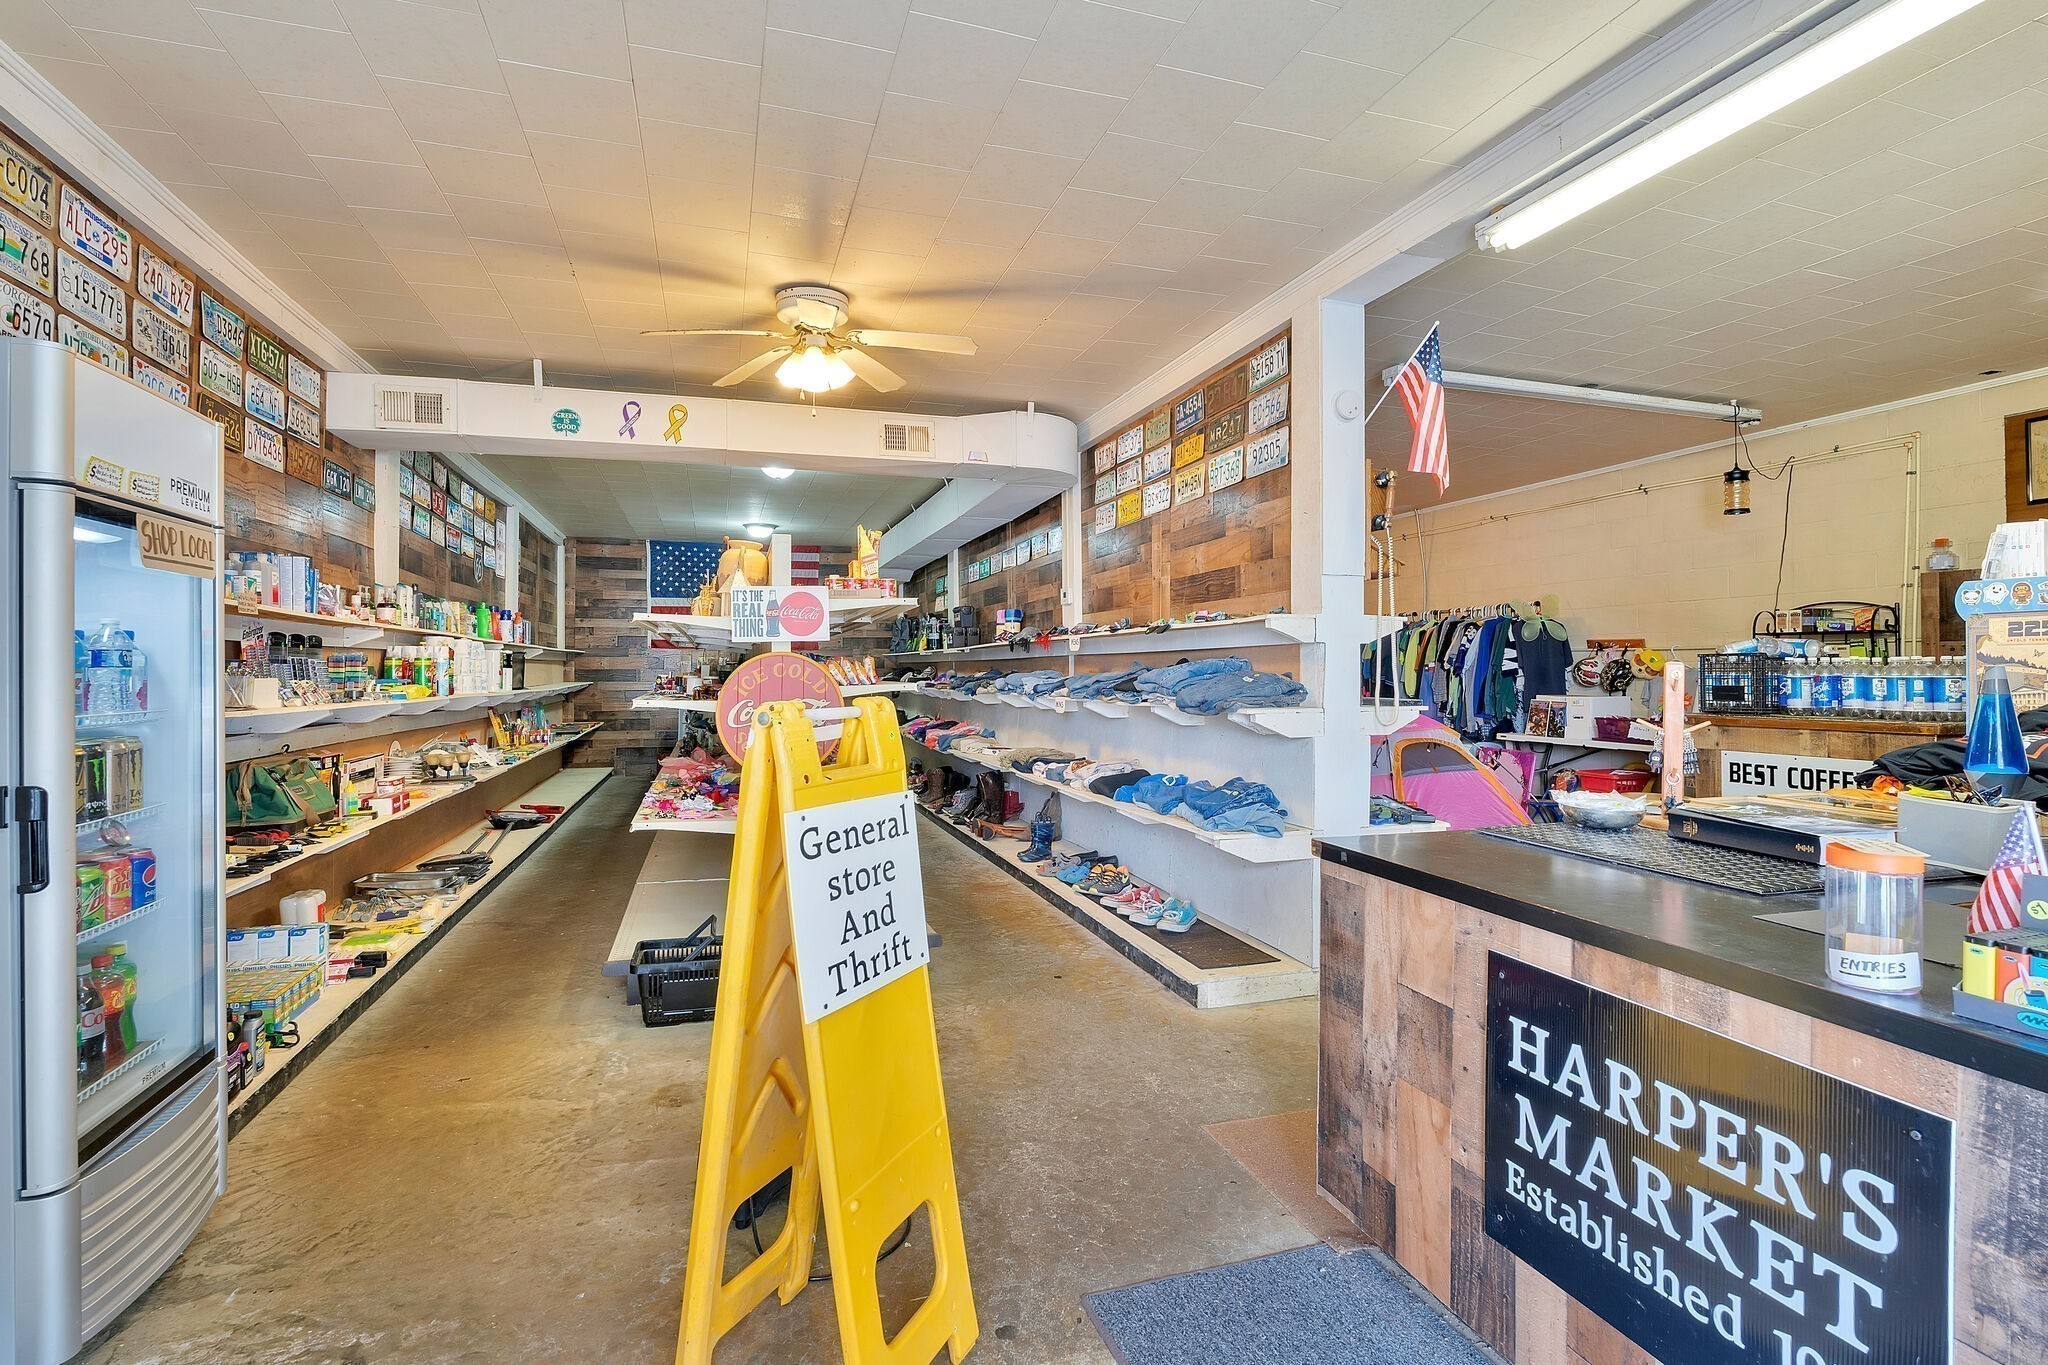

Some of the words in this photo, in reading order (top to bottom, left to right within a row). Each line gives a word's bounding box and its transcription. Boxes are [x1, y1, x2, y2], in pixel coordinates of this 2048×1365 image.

[79, 201, 115, 234] Tennessee
[66, 204, 91, 242] ALC
[102, 230, 128, 266] 295
[20, 237, 49, 278] 768
[80, 265, 110, 292] TENNESSEE
[144, 261, 162, 293] 240
[171, 281, 190, 314] RXZ
[0, 285, 36, 310] ORGIA
[75, 275, 114, 319] 15177
[13, 303, 51, 341] 6579
[149, 311, 178, 336] TENNESSEE
[217, 312, 243, 347] D3846
[162, 330, 188, 364] 5644
[1276, 346, 1286, 369] TV
[250, 384, 265, 408] 254
[1252, 440, 1281, 466] 92305
[171, 477, 210, 504] PREMIUM
[181, 497, 210, 513] LEVELLA
[141, 520, 177, 556] SHOP
[180, 531, 215, 561] LOCAL
[732, 590, 747, 602] IT'S
[749, 590, 763, 602] THE
[732, 603, 764, 618] REAL
[733, 619, 764, 638] THING
[734, 667, 769, 697] ICE
[773, 663, 829, 694] COLD
[1729, 762, 1777, 787] BEST
[799, 803, 910, 860] General
[827, 859, 896, 901] store
[840, 891, 897, 946] And
[828, 931, 913, 997] Thrift
[1840, 956, 1907, 974] ENTRIES
[1507, 1015, 1899, 1254] HARPER'S
[1514, 1093, 1884, 1354] MARKET
[1505, 1159, 1746, 1349] Established
